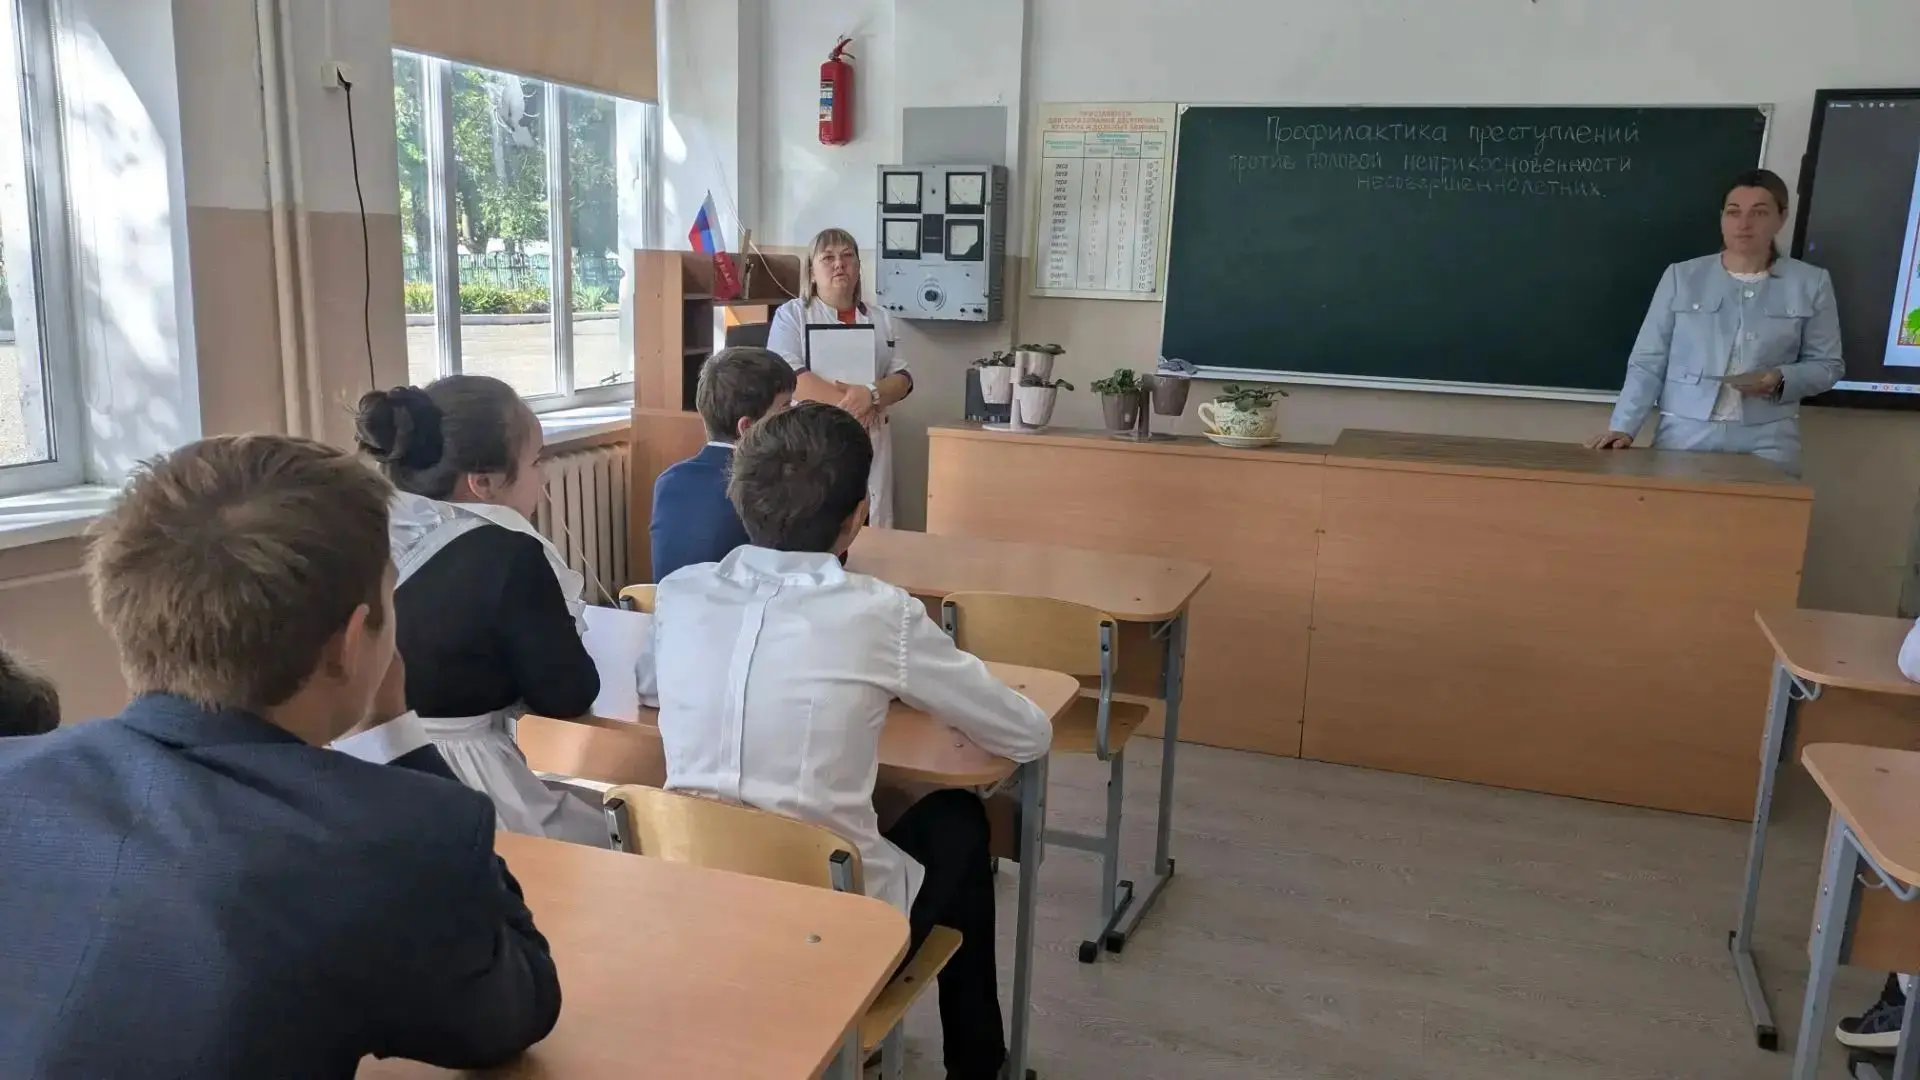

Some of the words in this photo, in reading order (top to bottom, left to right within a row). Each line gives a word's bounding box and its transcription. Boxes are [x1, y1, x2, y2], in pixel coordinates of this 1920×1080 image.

[1265, 115, 1449, 154] Профилактика
[1468, 121, 1641, 156] преступлений
[1228, 153, 1297, 184] против
[1305, 151, 1382, 170] половой
[1403, 154, 1632, 178] неприкосновенности
